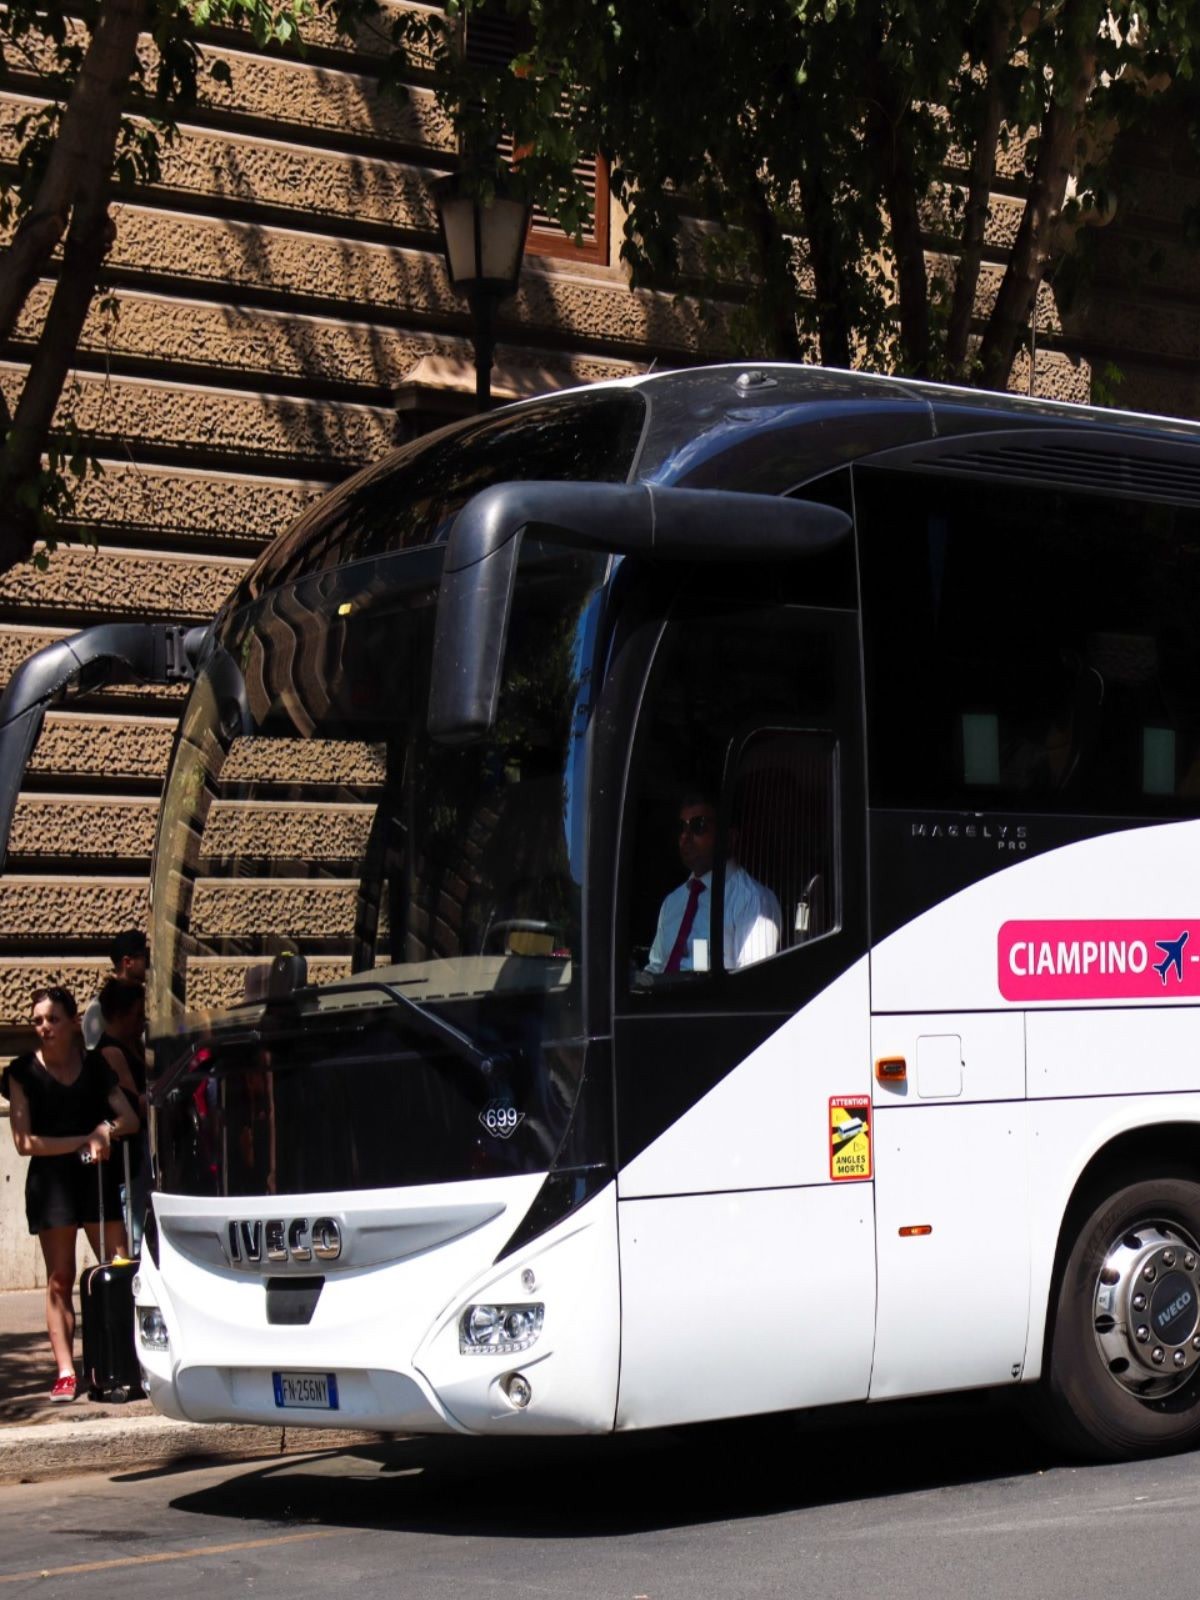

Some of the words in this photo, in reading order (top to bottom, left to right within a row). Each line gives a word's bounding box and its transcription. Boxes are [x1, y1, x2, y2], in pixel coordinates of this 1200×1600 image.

[998, 841, 1027, 850] PRO
[1009, 940, 1149, 976] CIAMPINO
[831, 1098, 868, 1106] ATTENTION
[486, 1107, 517, 1128] 699
[836, 1155, 866, 1164] ANGLES
[838, 1164, 865, 1173] MORTS
[228, 1217, 342, 1262] IVECO
[1158, 1291, 1191, 1327] IVECO
